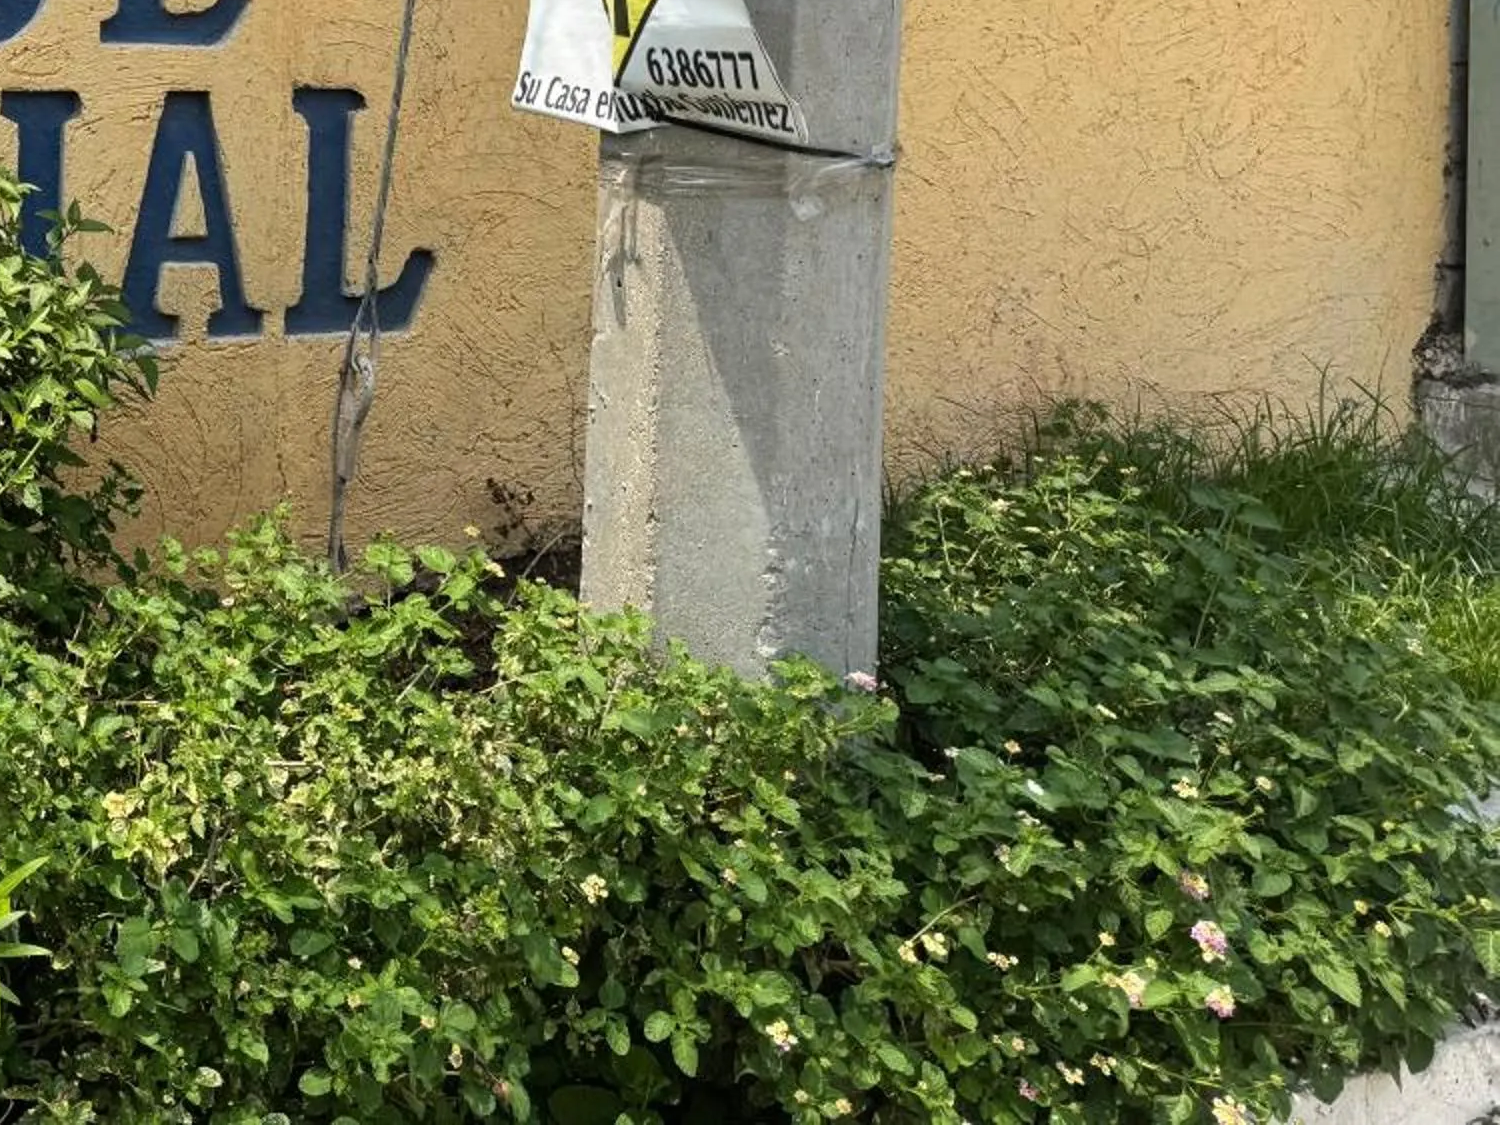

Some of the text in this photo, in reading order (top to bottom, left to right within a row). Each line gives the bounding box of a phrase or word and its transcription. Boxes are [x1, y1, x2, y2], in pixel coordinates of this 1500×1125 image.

[646, 47, 759, 90] 6386777
[514, 70, 542, 106] Su
[545, 75, 591, 115] Casa
